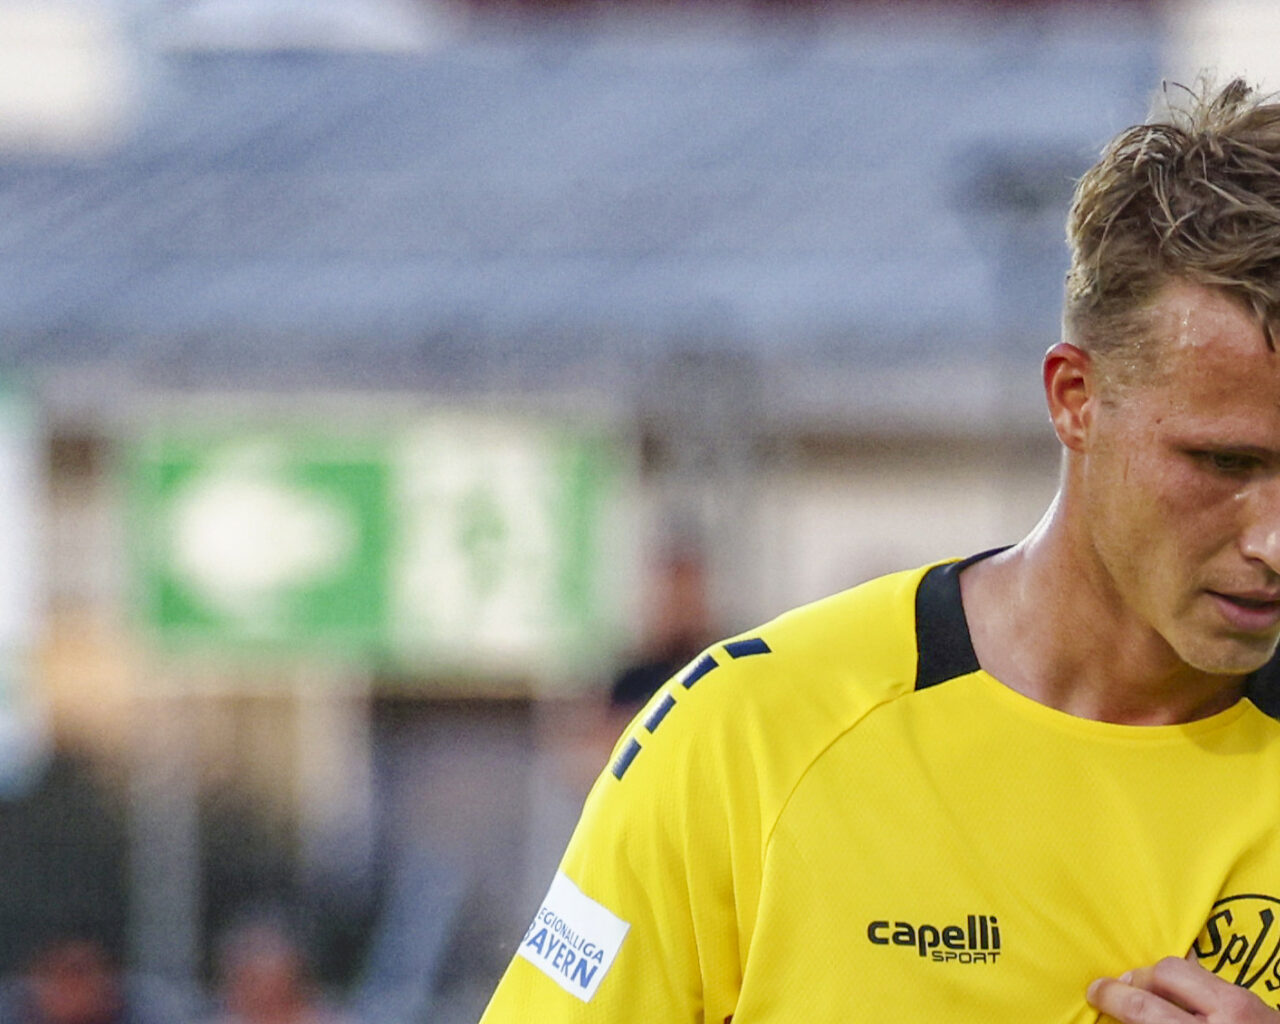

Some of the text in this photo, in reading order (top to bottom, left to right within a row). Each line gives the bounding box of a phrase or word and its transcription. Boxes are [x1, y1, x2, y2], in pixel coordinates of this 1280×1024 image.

[537, 907, 604, 964] EGIONALLIGA
[867, 914, 1001, 957] capelli
[931, 950, 1001, 964] SPORT
